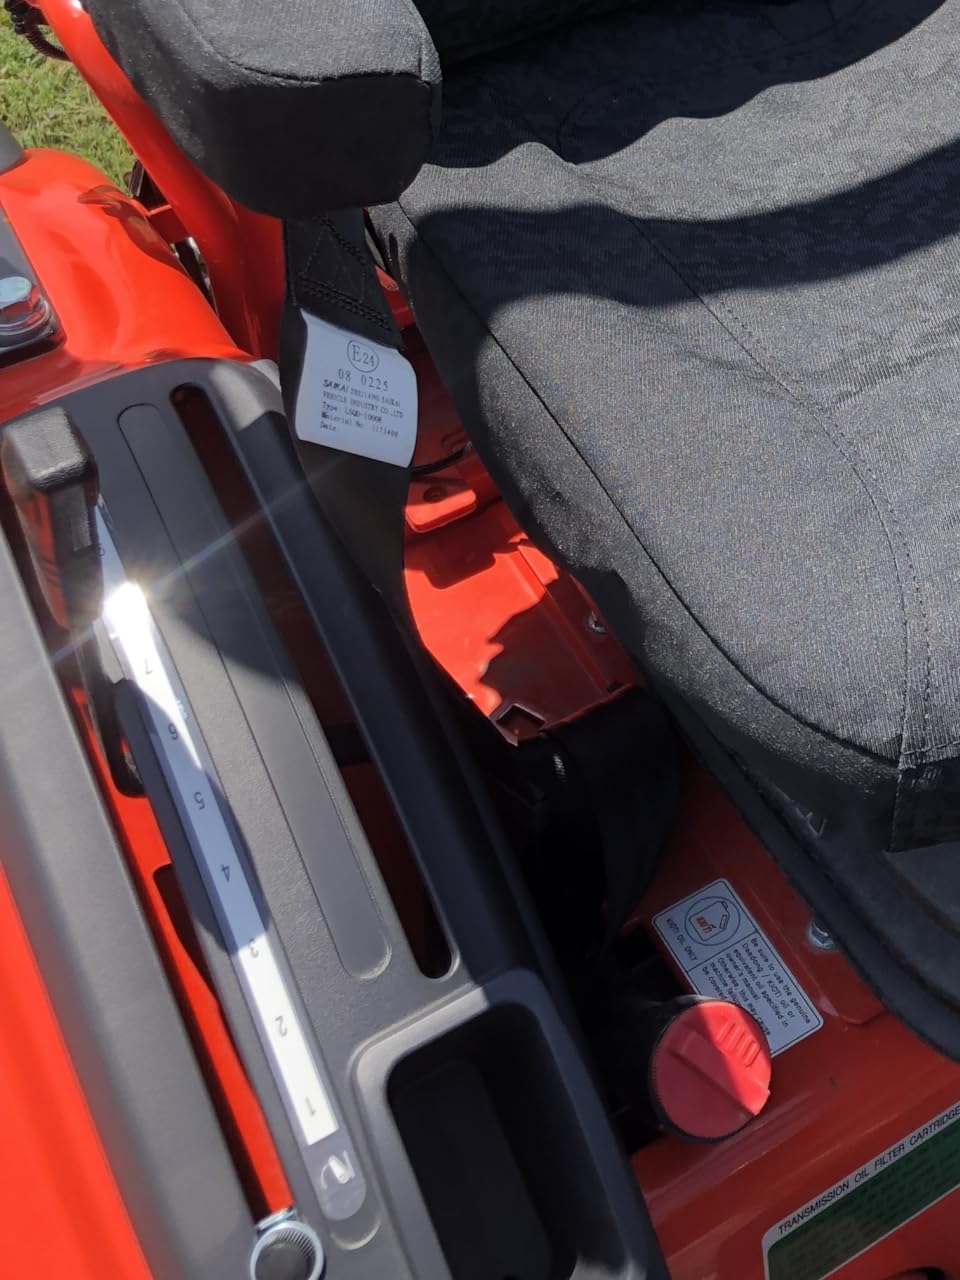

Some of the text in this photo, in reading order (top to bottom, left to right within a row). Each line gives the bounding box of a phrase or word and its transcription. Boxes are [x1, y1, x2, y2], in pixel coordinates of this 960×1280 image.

[338, 368, 388, 392] 08 0225
[167, 722, 179, 740] 6
[193, 791, 205, 810] 5
[221, 863, 232, 883] 4
[249, 937, 260, 959] 3
[684, 945, 698, 961] ONLY
[702, 966, 710, 976] be
[710, 962, 728, 987] machine
[742, 942, 763, 973] Daedong
[767, 980, 782, 998] KIOTI
[780, 999, 790, 1009] oil
[787, 1010, 795, 1018] or
[751, 937, 811, 1024] Be sure to use the genuine
[733, 948, 789, 1028] equivalent oil specified in
[740, 990, 749, 1002] this
[274, 1014, 288, 1037] 2
[304, 1095, 316, 1117] 1
[778, 1180, 850, 1235] TRANSMISSION
[854, 1168, 871, 1184] OIL
[874, 1142, 906, 1169] FILTER
